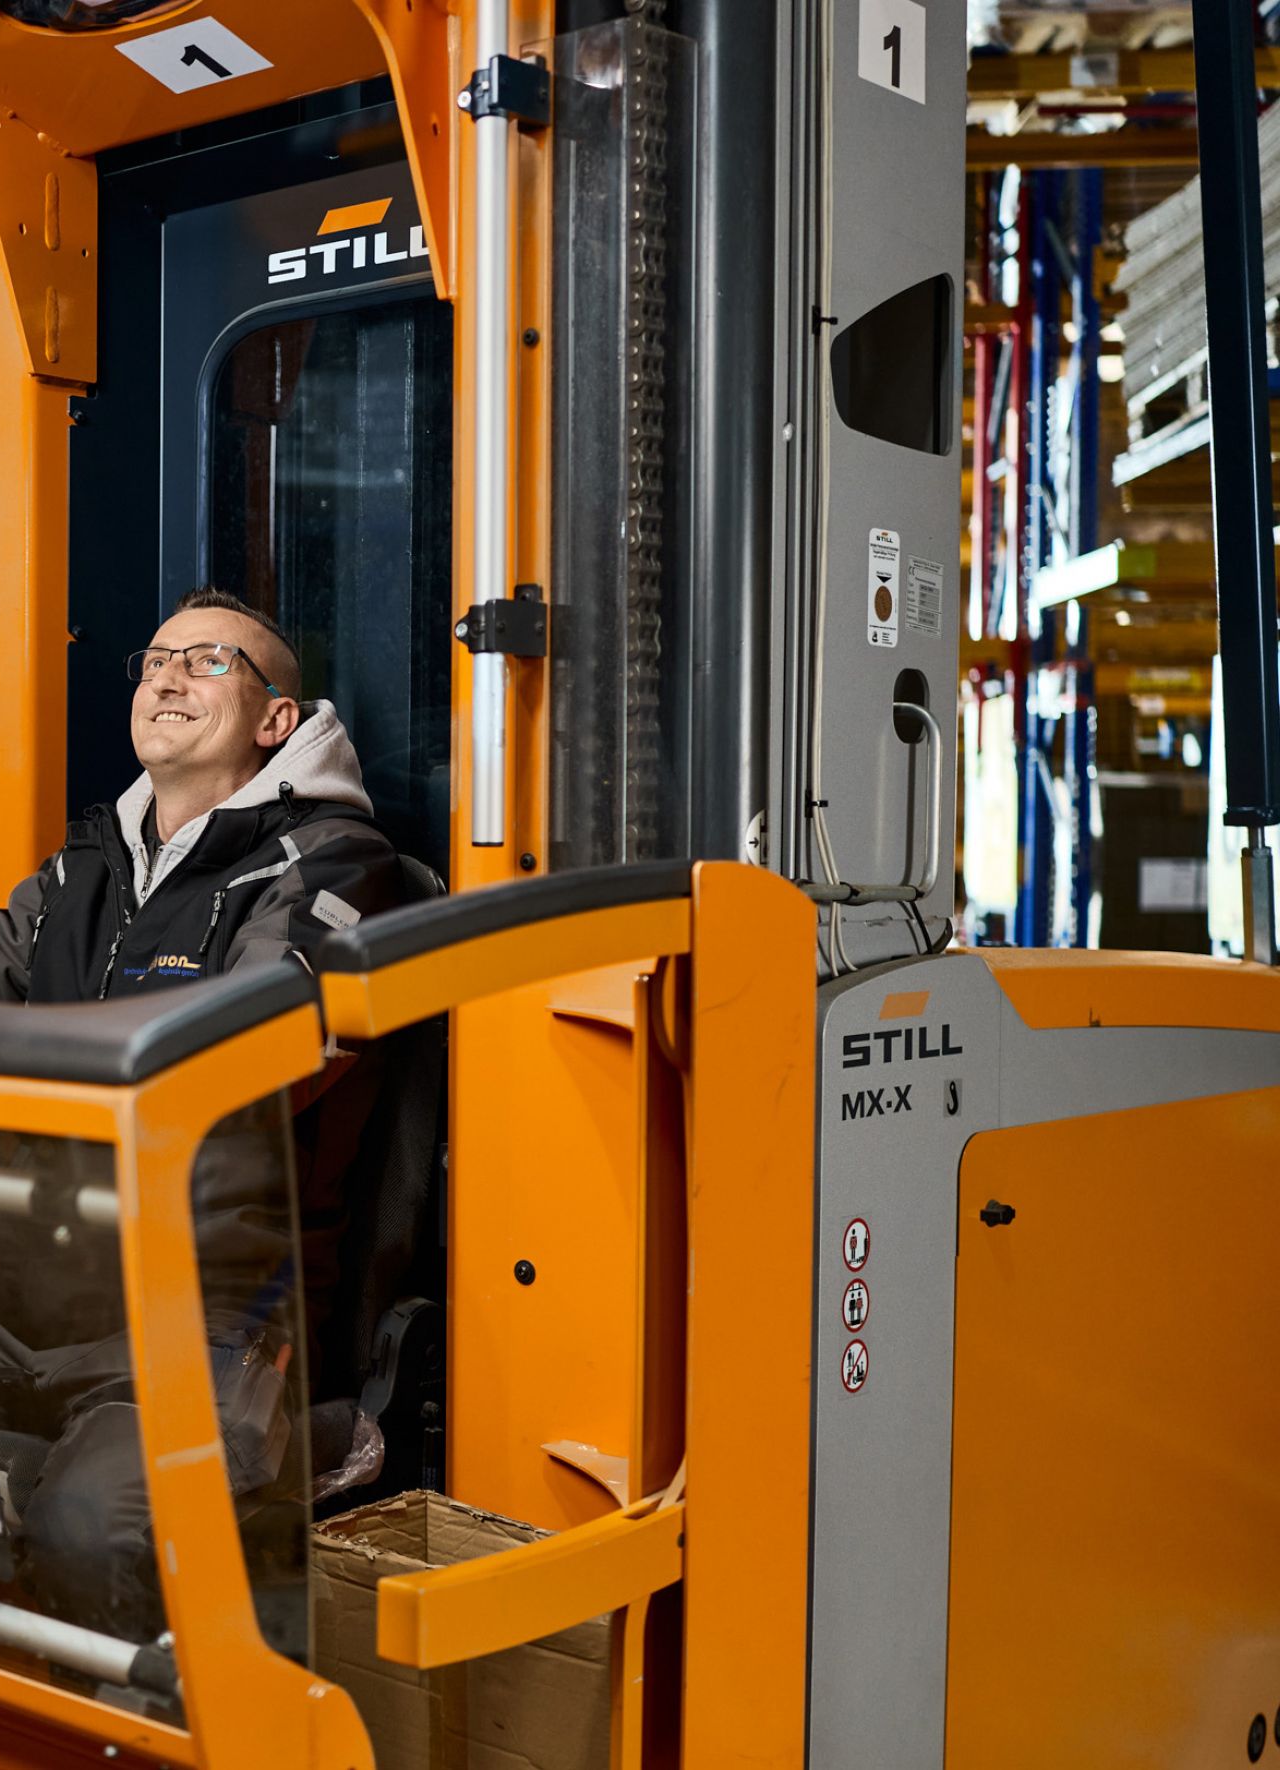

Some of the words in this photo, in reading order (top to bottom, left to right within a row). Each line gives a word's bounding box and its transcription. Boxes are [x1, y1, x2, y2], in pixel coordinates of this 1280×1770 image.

[180, 44, 233, 78] 1
[883, 25, 901, 89] 1
[842, 1023, 963, 1069] STILL
